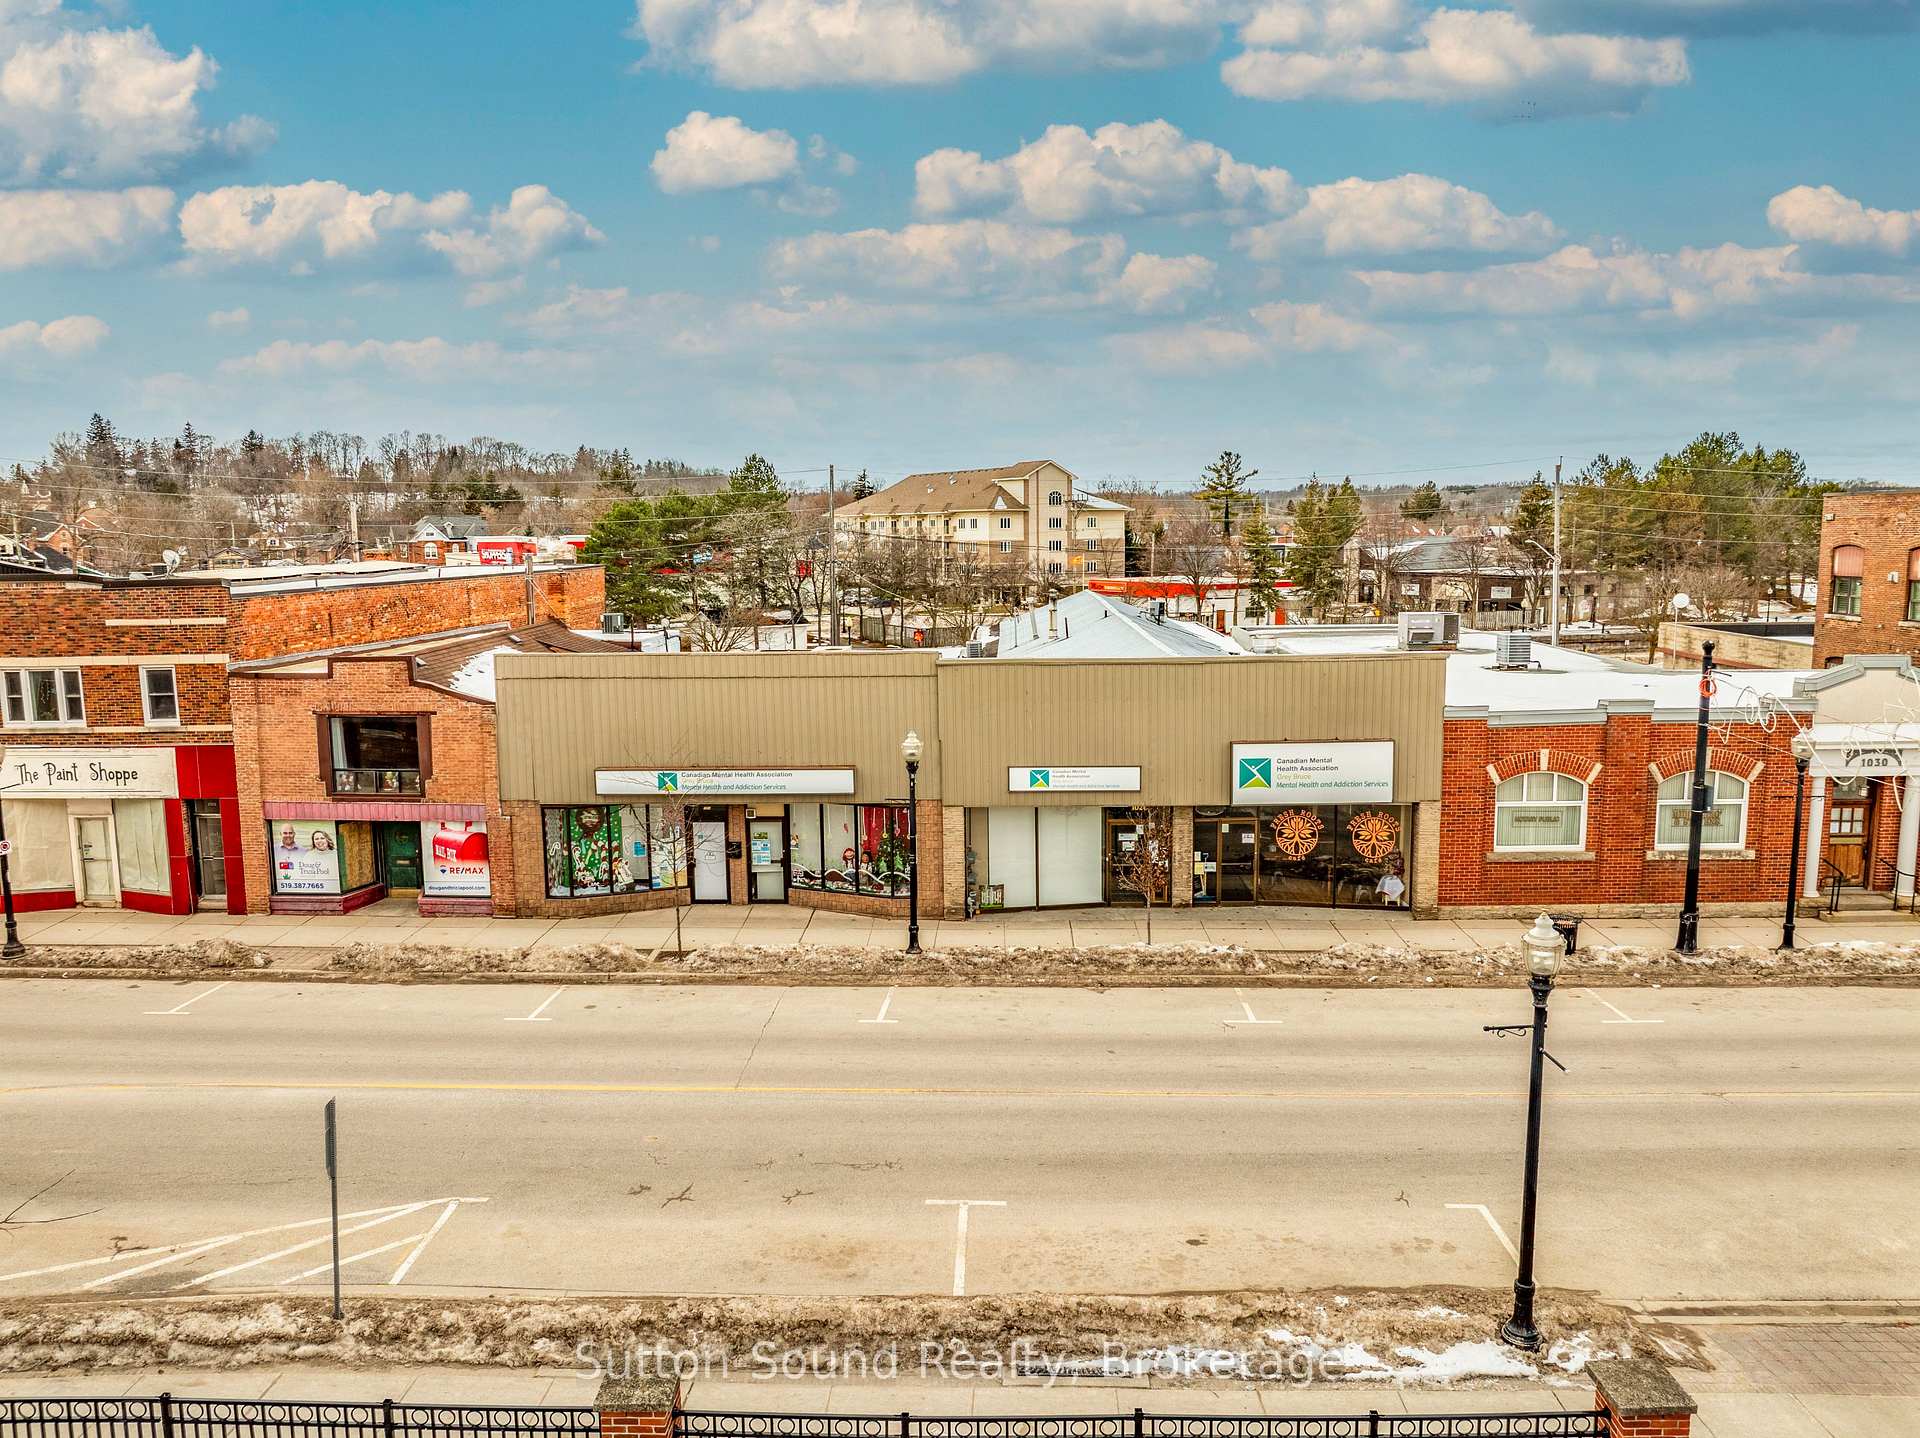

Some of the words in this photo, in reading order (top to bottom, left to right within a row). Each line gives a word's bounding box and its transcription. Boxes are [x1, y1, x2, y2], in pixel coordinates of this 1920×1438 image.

[1862, 758, 1888, 767] 1030
[15, 762, 39, 785] The
[43, 762, 79, 785] Paint
[89, 762, 139, 786] Shoppe
[1277, 773, 1291, 781] Grey
[1334, 780, 1362, 788] Addiction
[1364, 780, 1388, 788] Services
